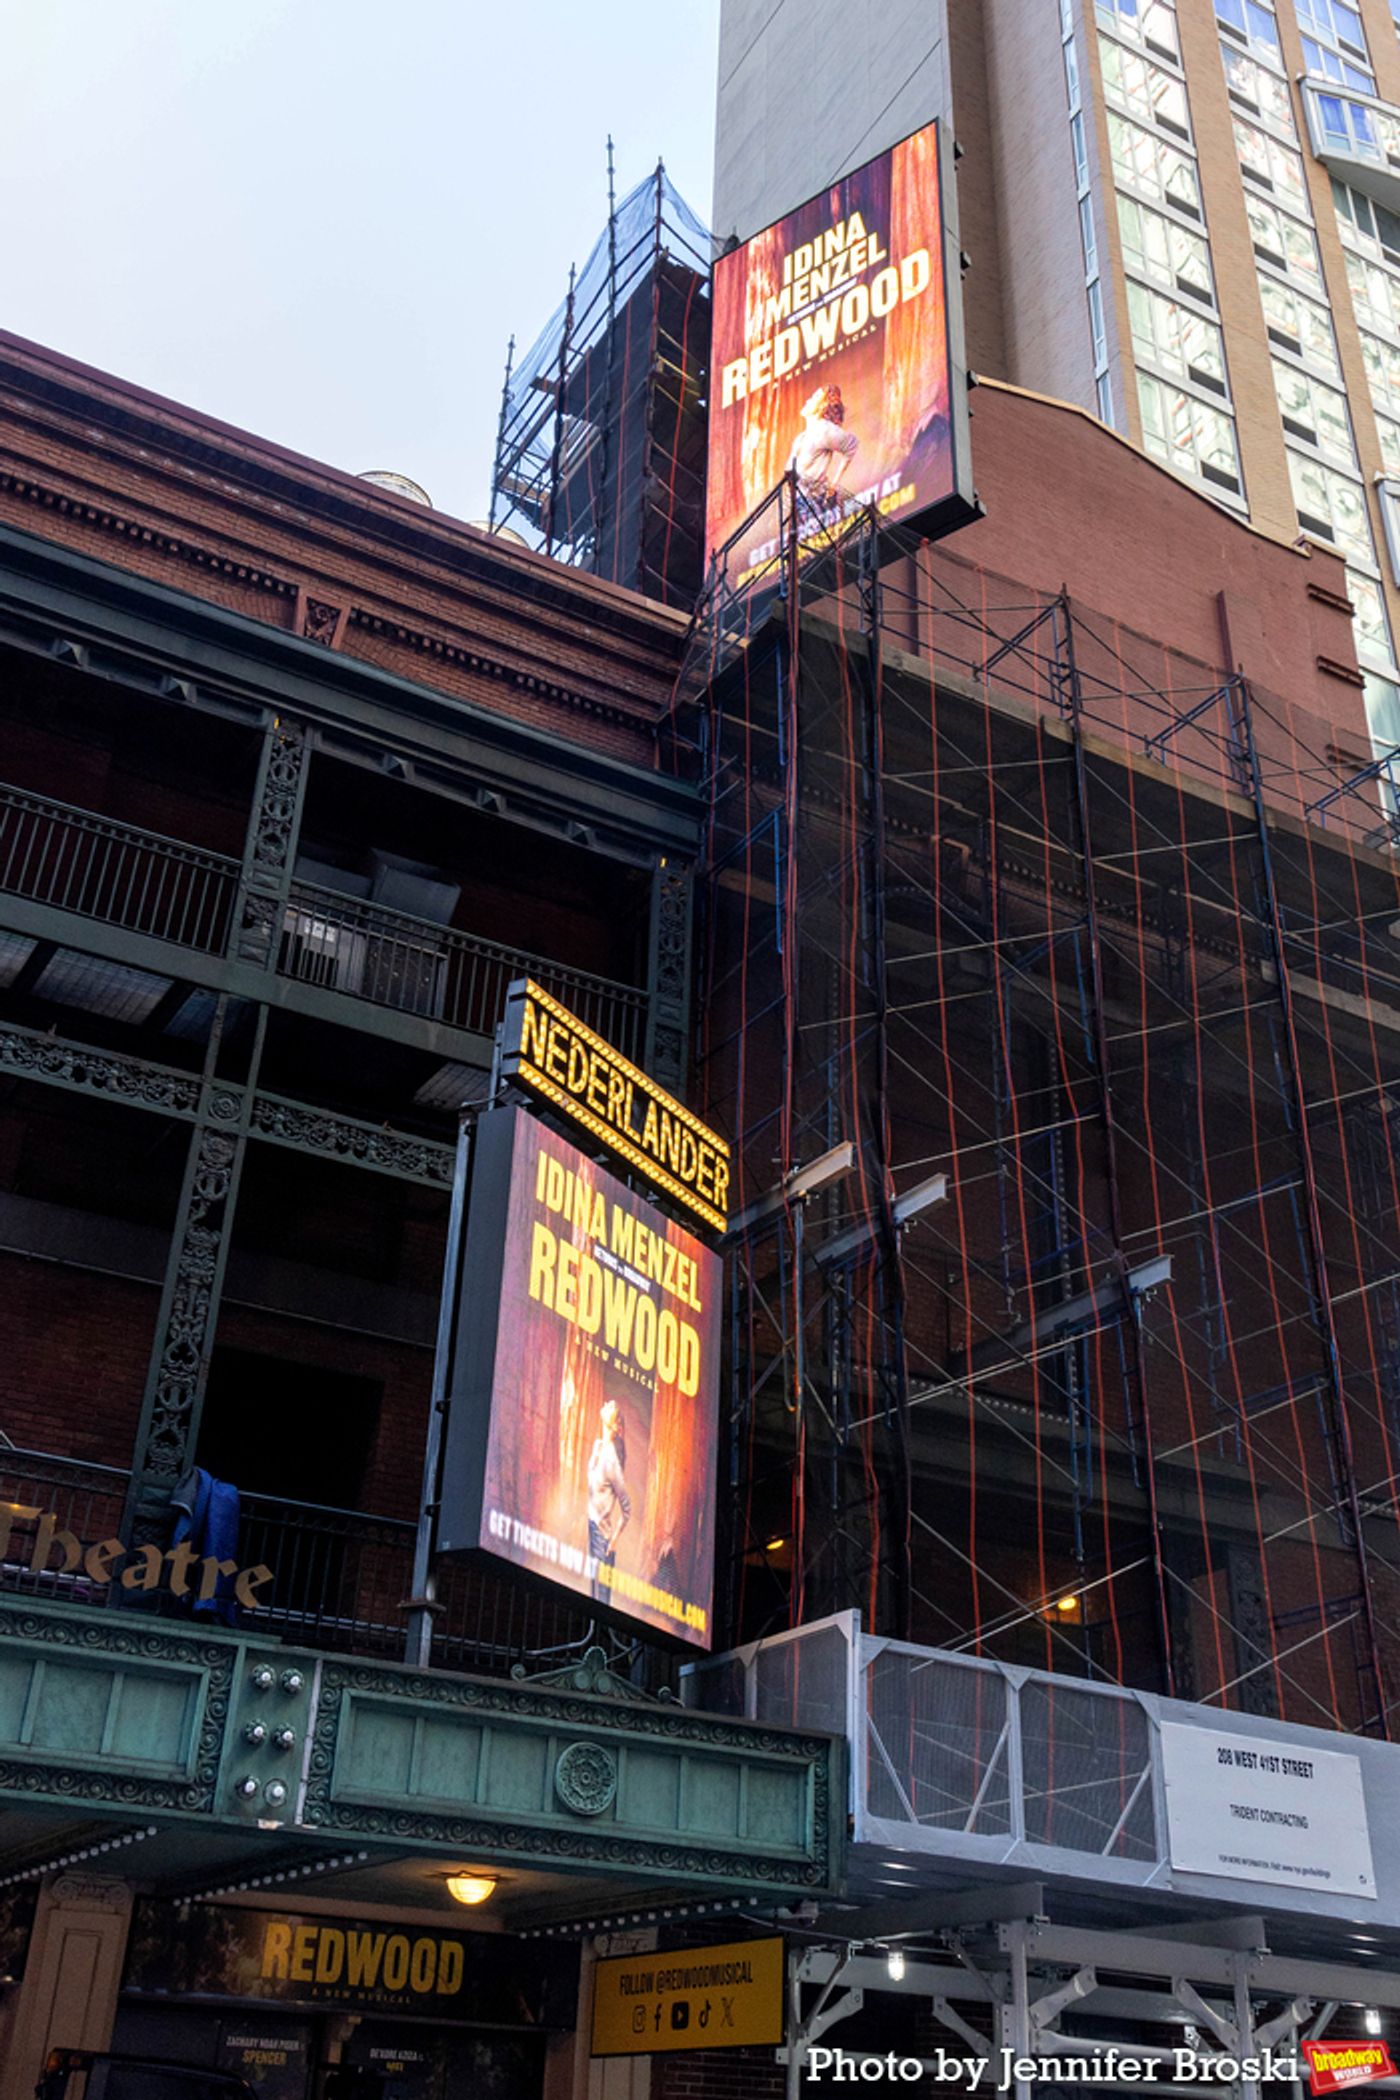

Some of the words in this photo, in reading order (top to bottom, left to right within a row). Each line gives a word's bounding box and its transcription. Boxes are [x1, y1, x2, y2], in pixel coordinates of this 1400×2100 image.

[765, 232, 887, 326] MENZEL
[783, 211, 866, 285] IDINA
[721, 247, 931, 409] REDWOOD
[519, 997, 730, 1211] NEDERLANDER
[535, 1150, 608, 1248] IDINA
[611, 1203, 702, 1314] MENZEL
[528, 1220, 700, 1399] REDWOOD
[587, 1341, 610, 1362] NEW
[613, 1357, 660, 1393] MUSICAL
[489, 1508, 511, 1541] GET
[1233, 1749, 1258, 1770] WEST
[1260, 1754, 1280, 1773] 41ST
[1282, 1757, 1314, 1779] STREET
[1229, 1803, 1259, 1821] TRIDENT
[1260, 1809, 1309, 1829] CONTRACTING
[260, 1921, 466, 1997] REDWOOD
[619, 1971, 654, 1996] FOLLOW
[656, 1960, 754, 1995] @REDWOODMUSICAL
[324, 1988, 349, 2000] NEW
[357, 1991, 412, 2005] MUSICAL
[241, 2049, 288, 2066] SPENCER
